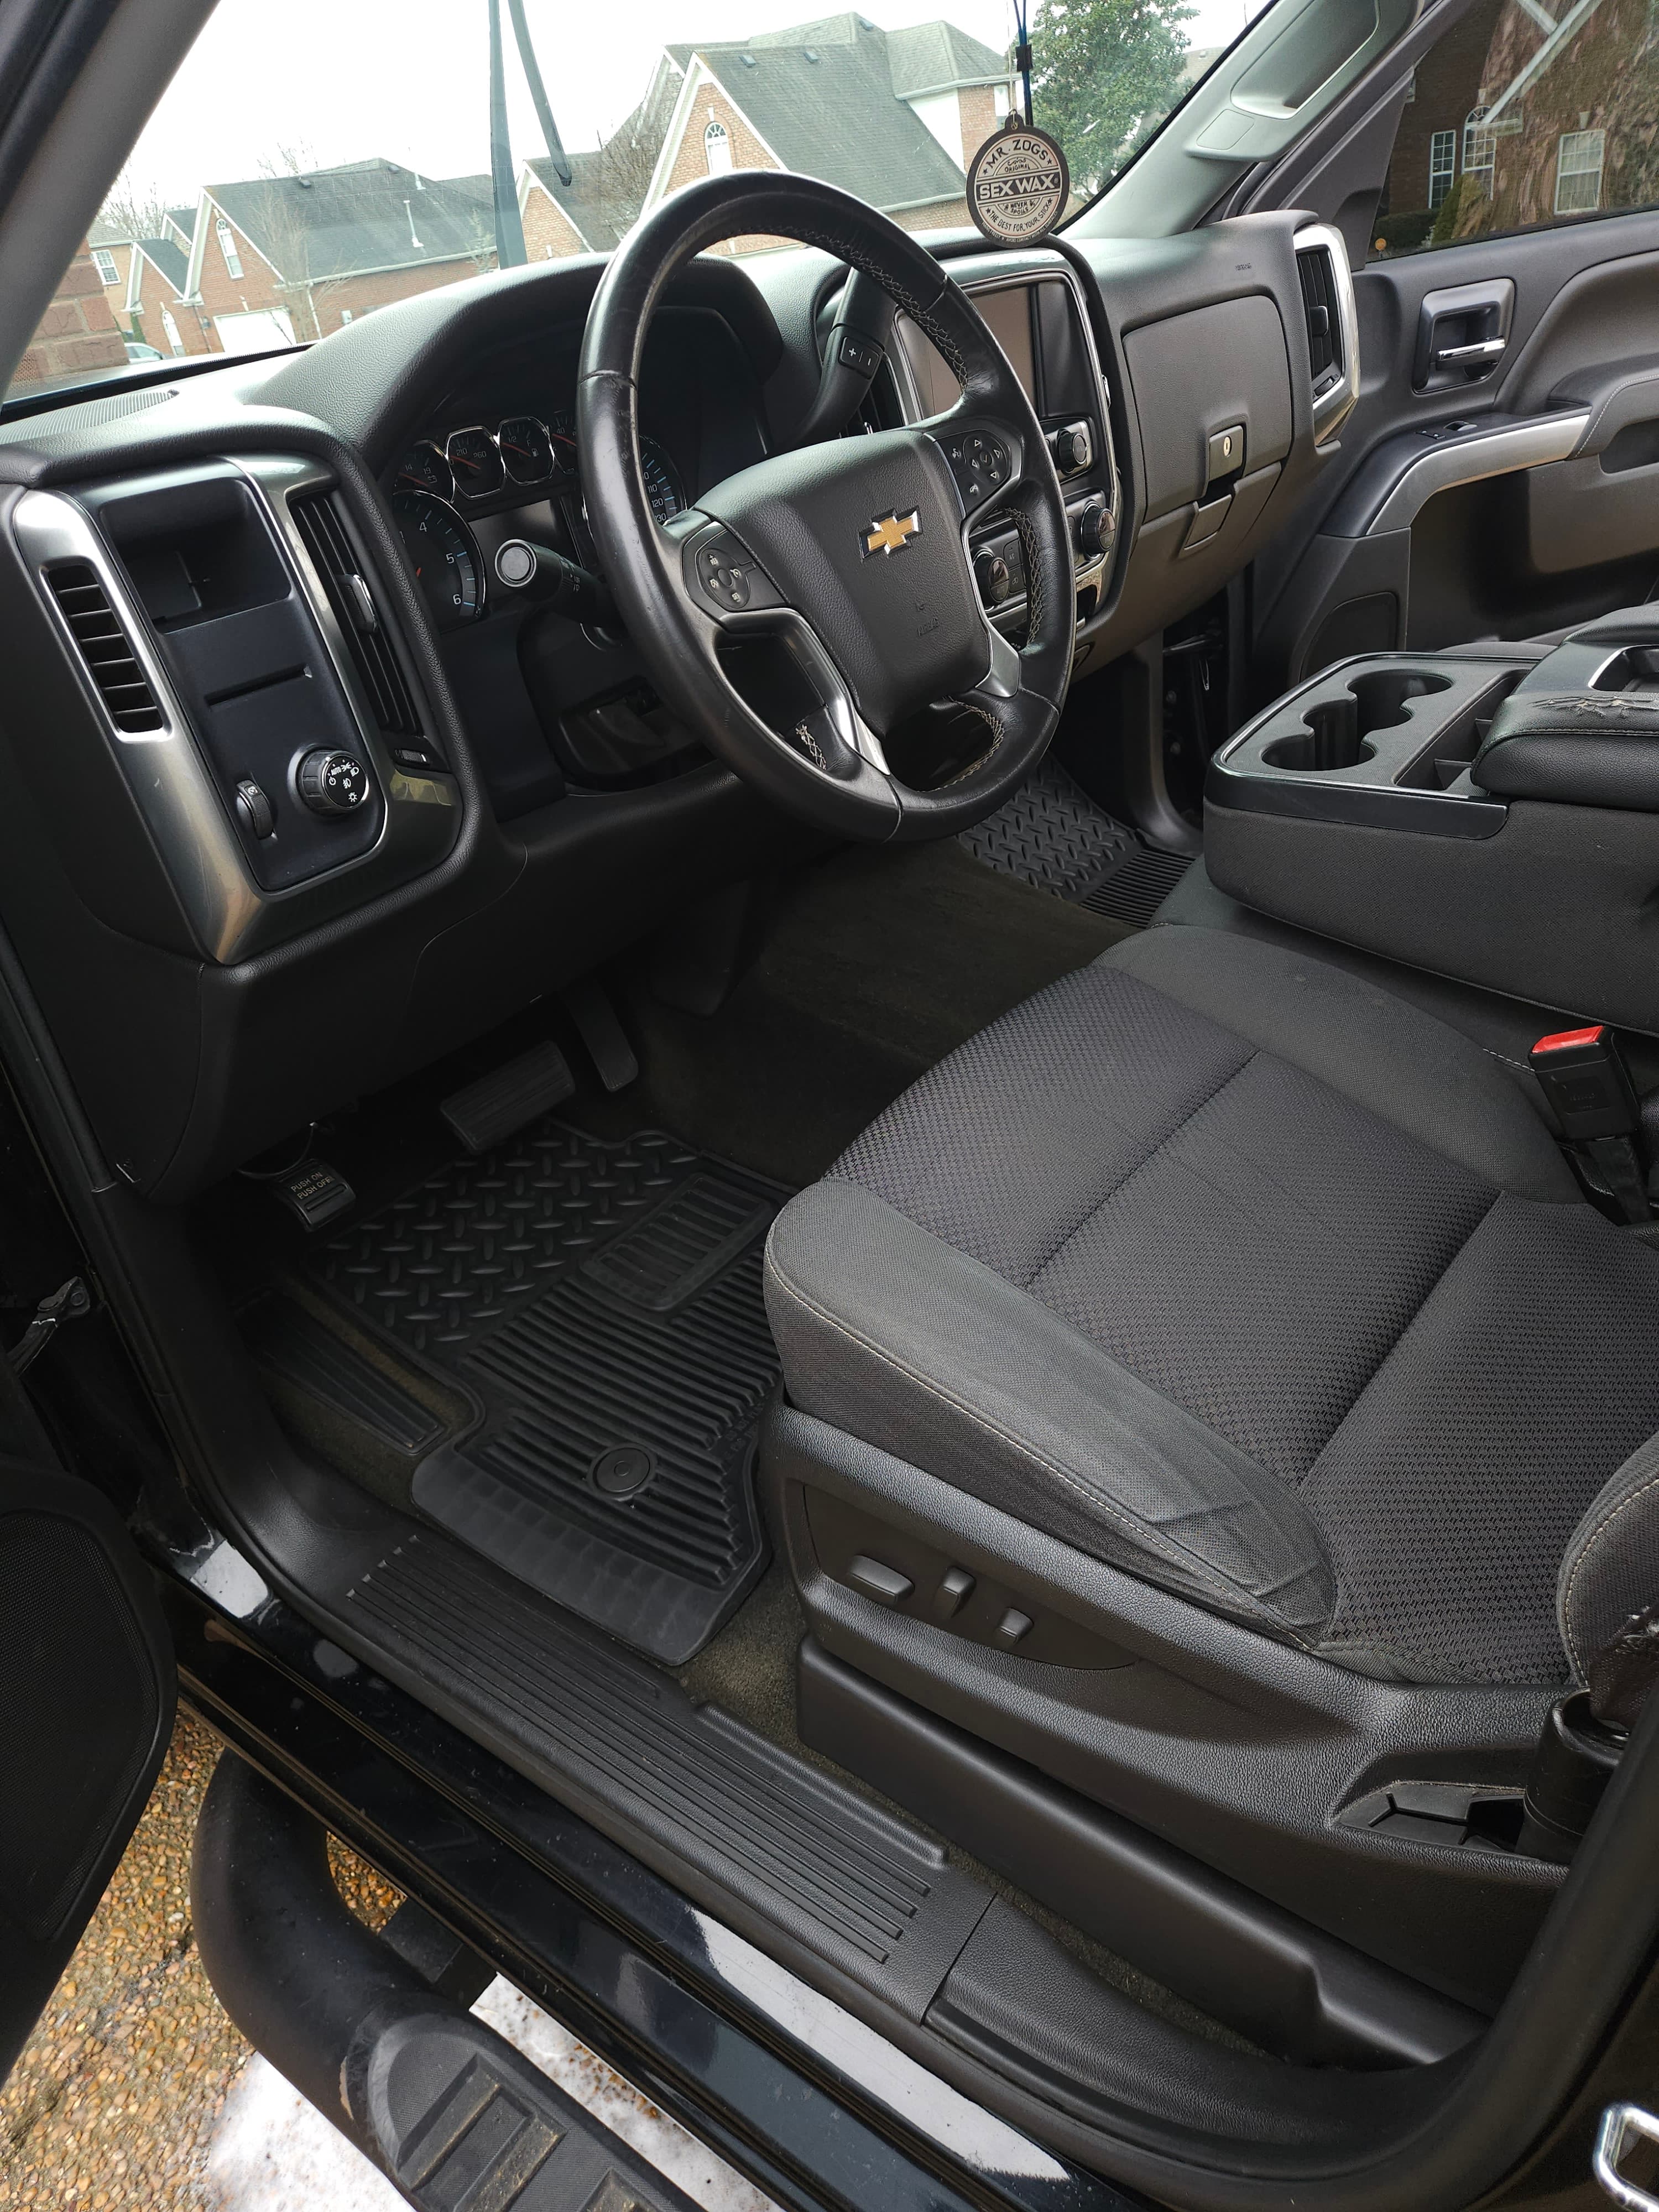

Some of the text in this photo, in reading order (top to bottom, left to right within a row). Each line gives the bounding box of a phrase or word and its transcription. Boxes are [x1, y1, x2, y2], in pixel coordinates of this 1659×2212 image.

[1012, 139, 1048, 161] ZOGS
[1004, 163, 1031, 173] ORIGINAL
[979, 173, 1055, 200] SEX WAX
[989, 211, 999, 223] THE
[997, 219, 1011, 231] BEST
[1013, 223, 1026, 232] FOR
[1024, 217, 1040, 229] YOUR
[456, 448, 468, 456] 210
[647, 484, 658, 494] 110
[651, 498, 664, 508] 120
[419, 521, 427, 533] 4
[446, 552, 455, 564] 5
[452, 593, 462, 605] 6
[331, 766, 342, 776] AUTO
[290, 1171, 323, 1192] PUSH ON
[296, 1176, 331, 1199] PUSH OFF
